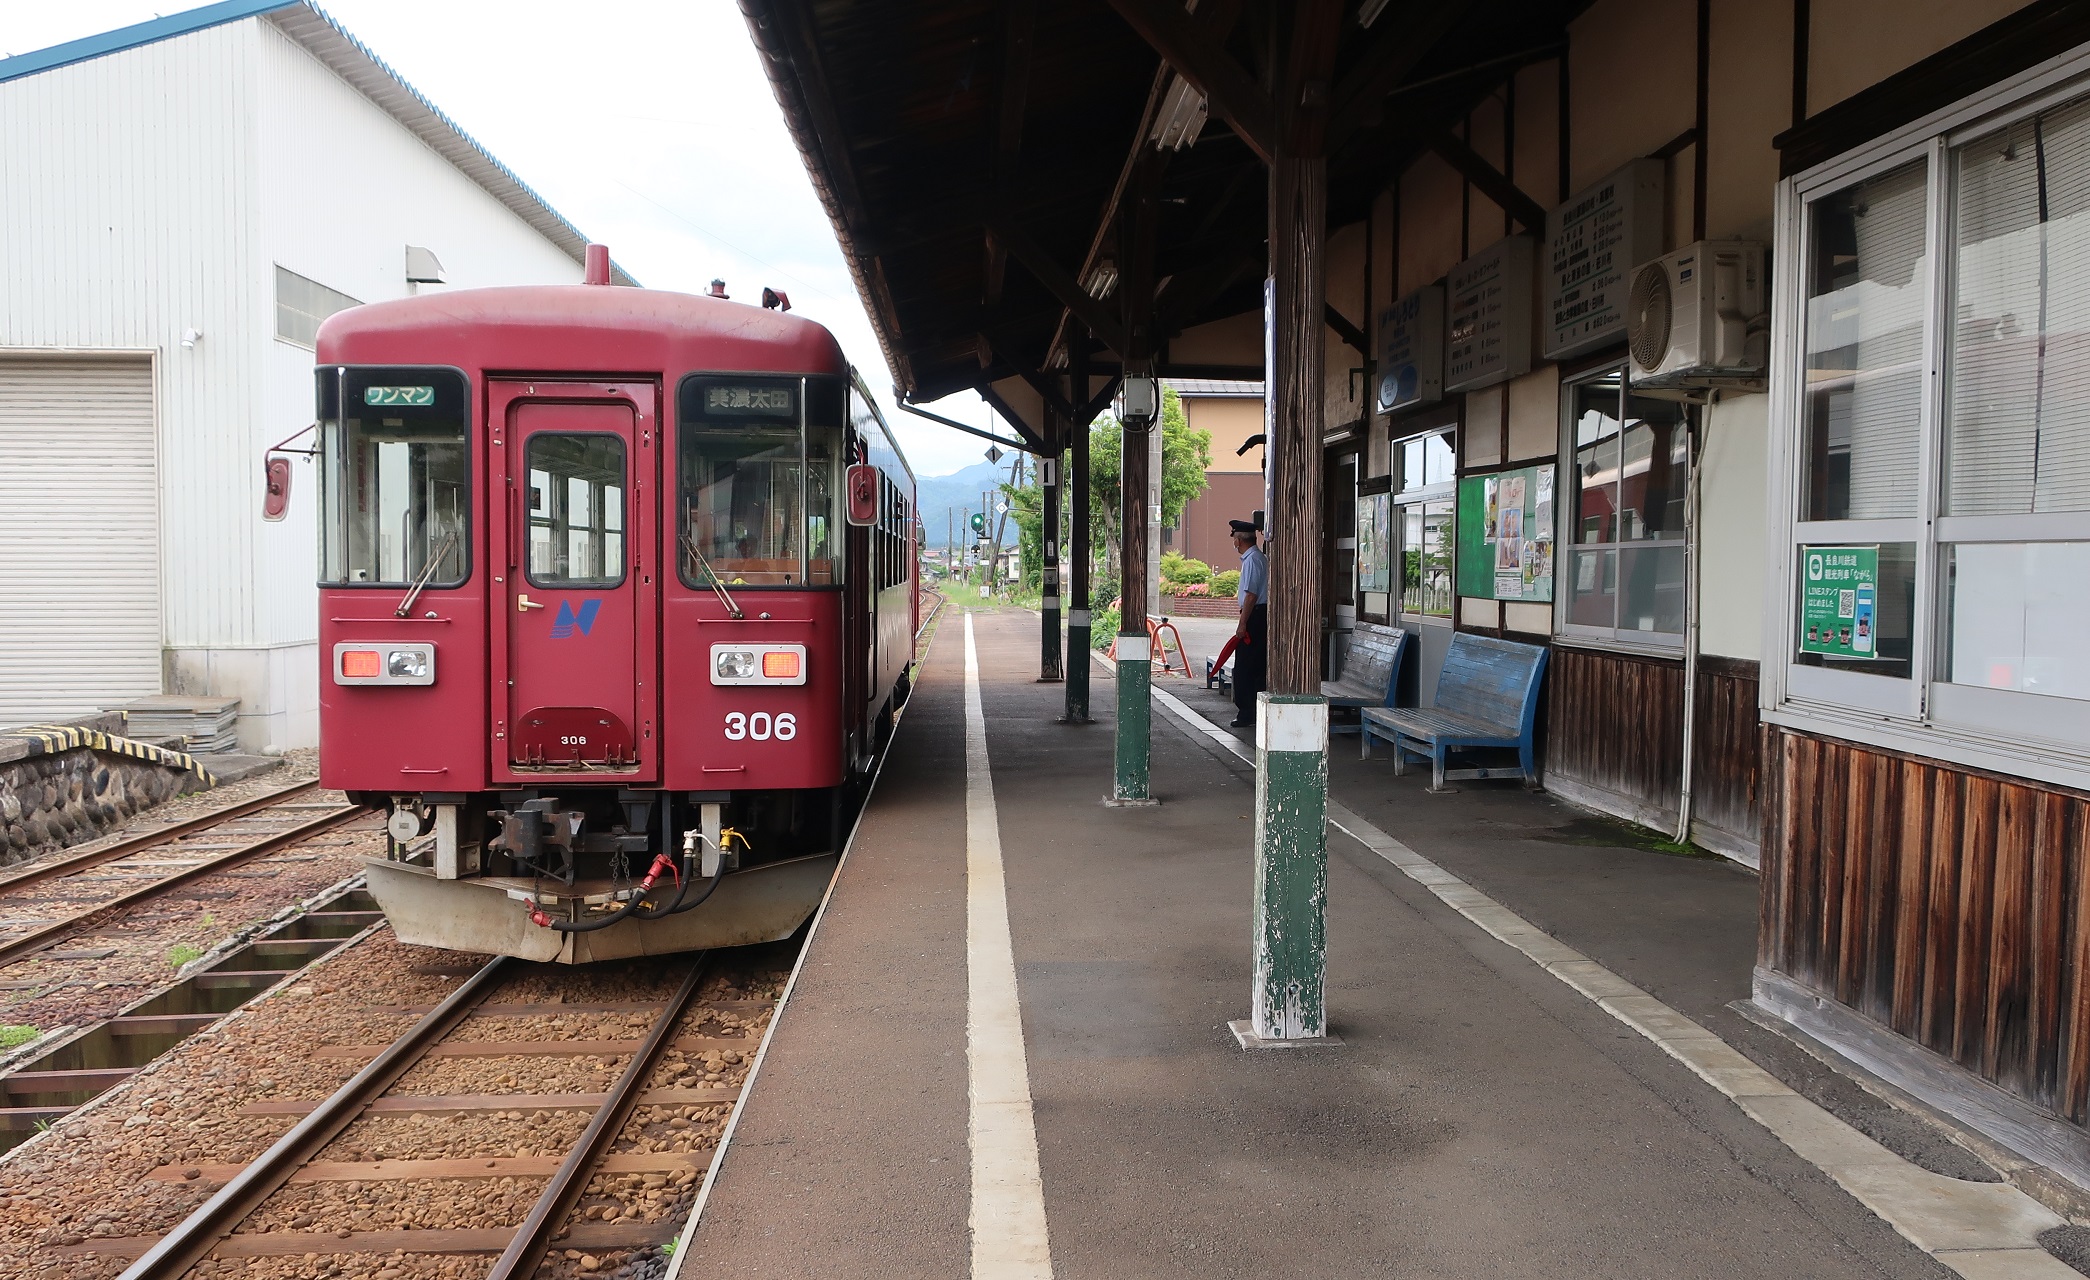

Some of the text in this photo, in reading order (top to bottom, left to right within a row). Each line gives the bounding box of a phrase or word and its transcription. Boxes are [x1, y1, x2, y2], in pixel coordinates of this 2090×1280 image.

[368, 387, 432, 403] ワンマン
[710, 388, 788, 409] 美濃太田
[1044, 461, 1048, 483] 1
[1825, 554, 1857, 567] 長良川鉄道
[1825, 569, 1873, 581] 観光列車「ながら」
[1808, 587, 1838, 596] LINEスタンプ
[725, 712, 796, 741] 306
[561, 736, 587, 745] 306
